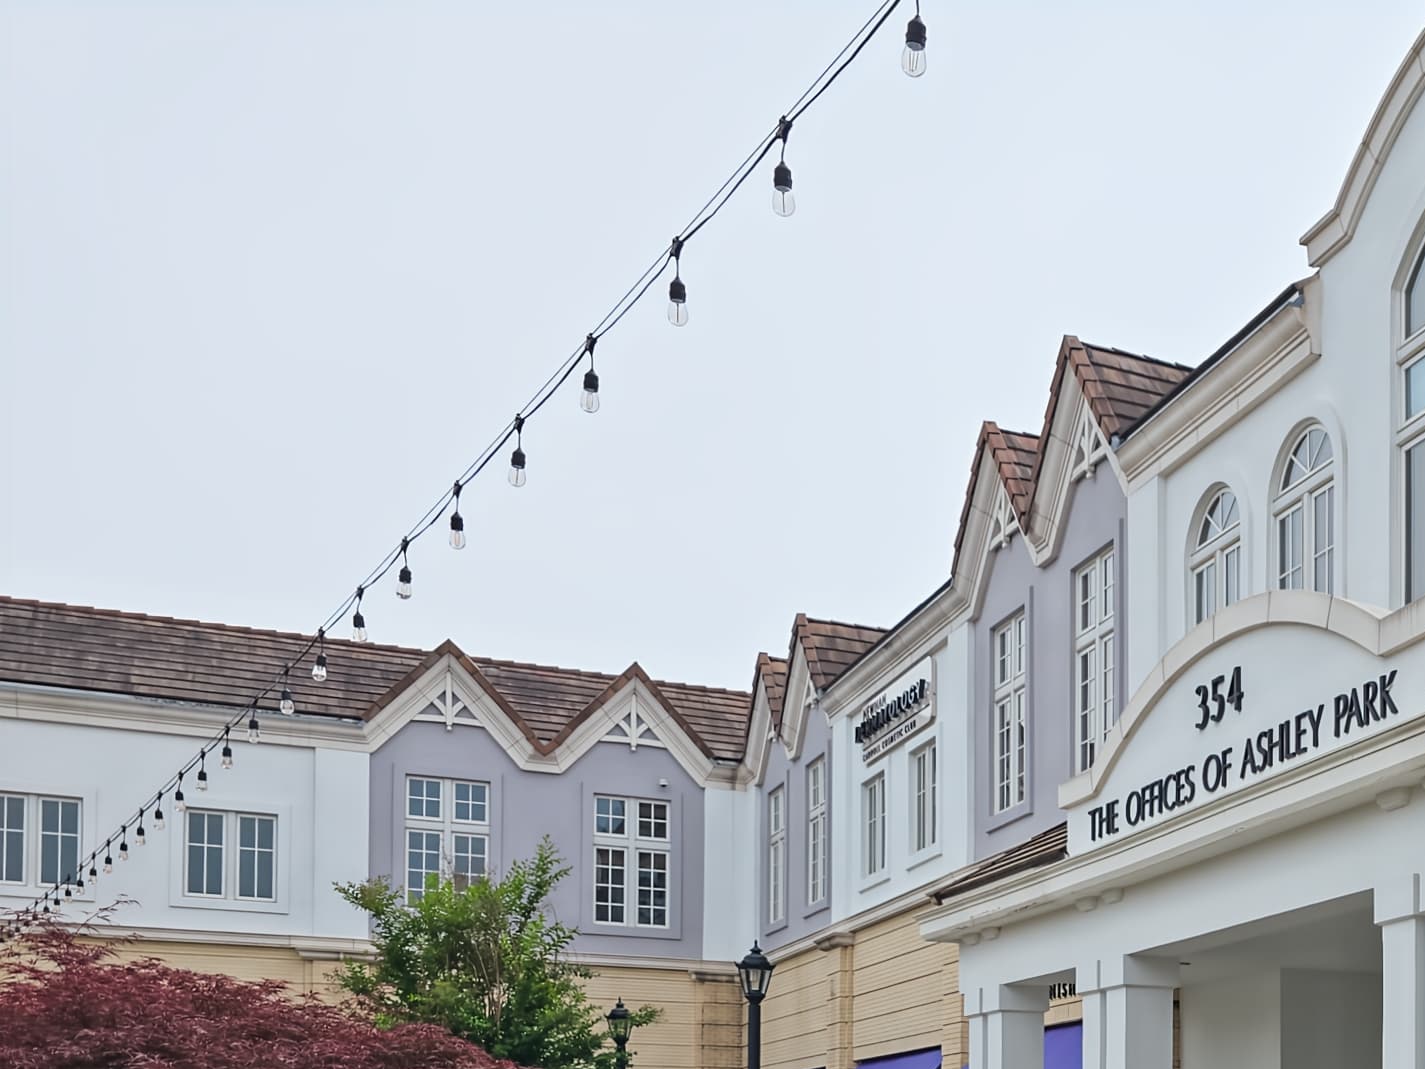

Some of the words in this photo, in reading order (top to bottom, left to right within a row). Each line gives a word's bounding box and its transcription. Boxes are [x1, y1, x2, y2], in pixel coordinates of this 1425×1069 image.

[1088, 800, 1119, 841] THE
[1126, 765, 1195, 826] OFFICES
[1202, 747, 1233, 792] OF
[1240, 704, 1324, 779] ASHLEY
[1334, 670, 1398, 737] PARK
[1195, 666, 1244, 731] 354
